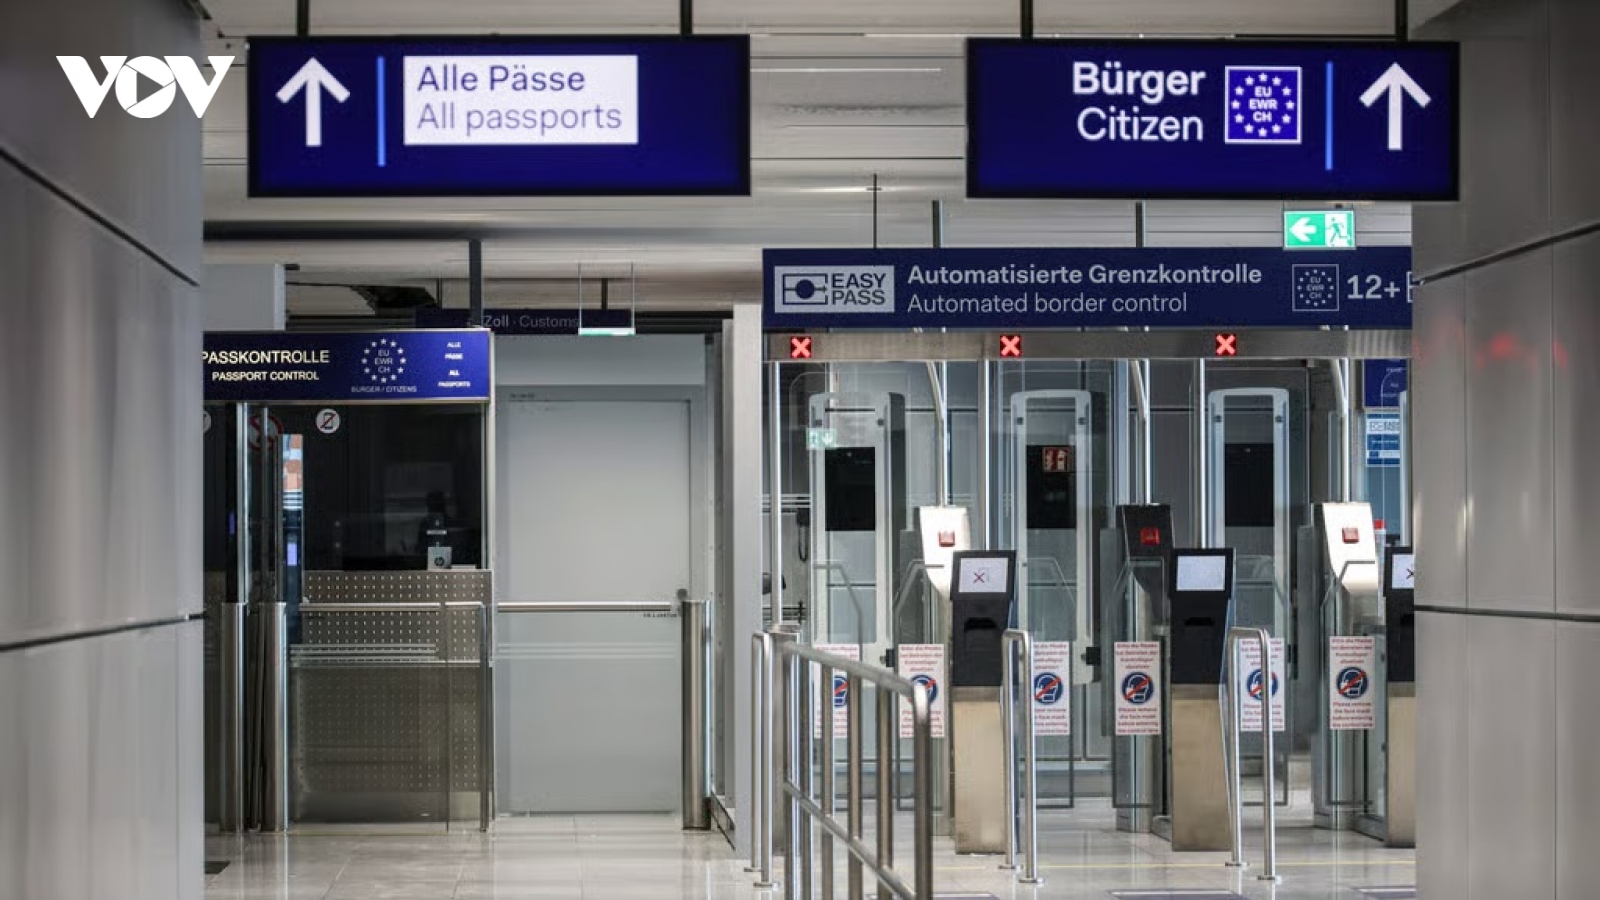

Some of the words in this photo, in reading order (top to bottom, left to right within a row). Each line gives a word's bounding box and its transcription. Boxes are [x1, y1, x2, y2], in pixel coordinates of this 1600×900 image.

[416, 64, 479, 92] Alle
[489, 64, 586, 92] Pässe
[1072, 60, 1206, 103] Bürger
[1254, 86, 1273, 98] EU
[1249, 98, 1278, 110] EWR
[416, 102, 455, 130] All
[466, 104, 622, 137] passports
[1077, 106, 1204, 141] Citizen
[1253, 110, 1273, 122] CH
[831, 272, 886, 289] EASY
[907, 263, 1082, 285] Automatisierte
[1088, 263, 1262, 285] Grenzkontrolle
[1347, 274, 1401, 299] 12+
[831, 289, 886, 306] PASS
[907, 291, 1028, 313] Automated
[1035, 291, 1107, 313] border
[1111, 291, 1187, 313] control
[483, 314, 509, 328] Zoll
[519, 314, 579, 328] Customs
[374, 357, 394, 365] EWR
[377, 349, 390, 357] EU
[211, 371, 268, 381] PASSPORT
[269, 370, 320, 381] CONTROL
[377, 366, 391, 374] CH
